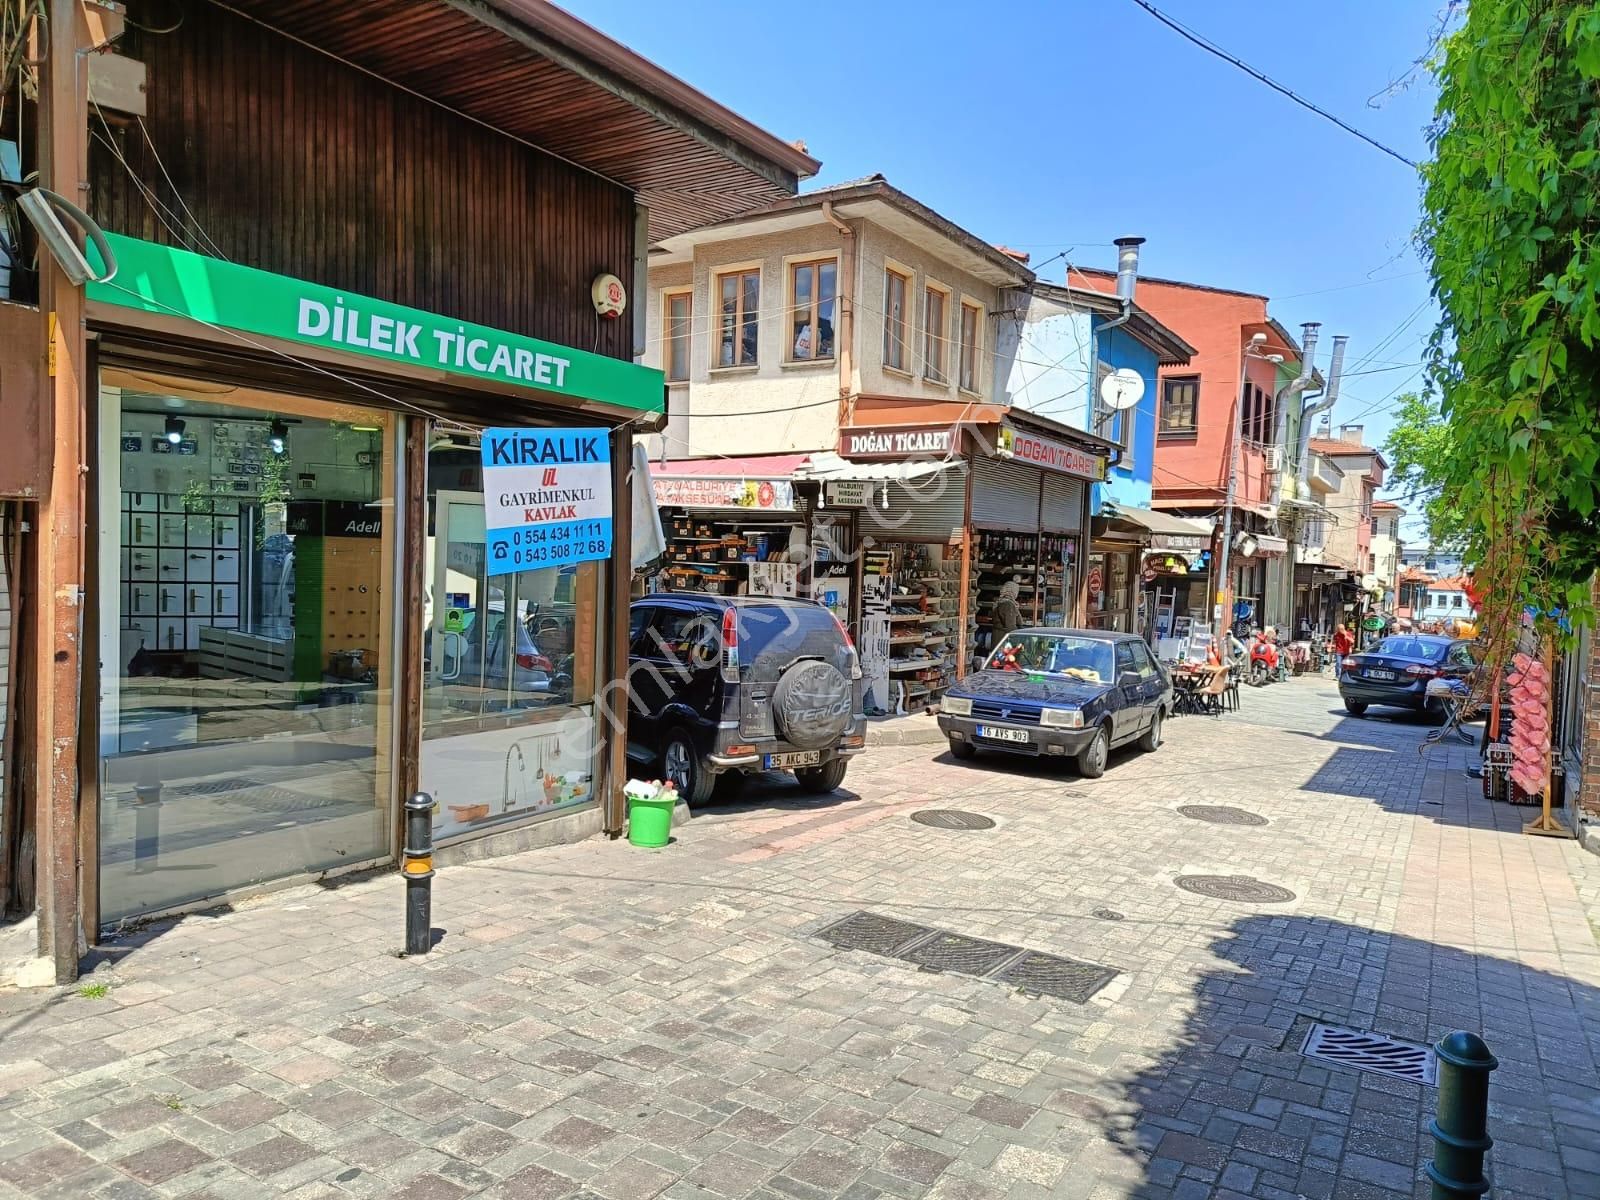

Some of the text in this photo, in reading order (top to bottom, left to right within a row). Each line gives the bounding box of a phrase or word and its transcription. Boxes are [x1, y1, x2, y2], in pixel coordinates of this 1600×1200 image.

[298, 296, 571, 387] DİLEK TİCARET
[491, 431, 599, 464] KİRALIK
[851, 431, 893, 453] DOĞAN
[500, 488, 595, 507] GAYRİMENKUL
[524, 505, 577, 522] KAVLAK
[345, 520, 380, 533] Adell
[513, 523, 602, 545] 0 554 434 11 11
[514, 540, 606, 564] 0 543 508 72 68
[829, 565, 847, 575] Adell
[791, 700, 851, 721] TERIOS
[983, 727, 1027, 742] 16 AVS 903
[771, 752, 819, 765] 35 AKC 943
